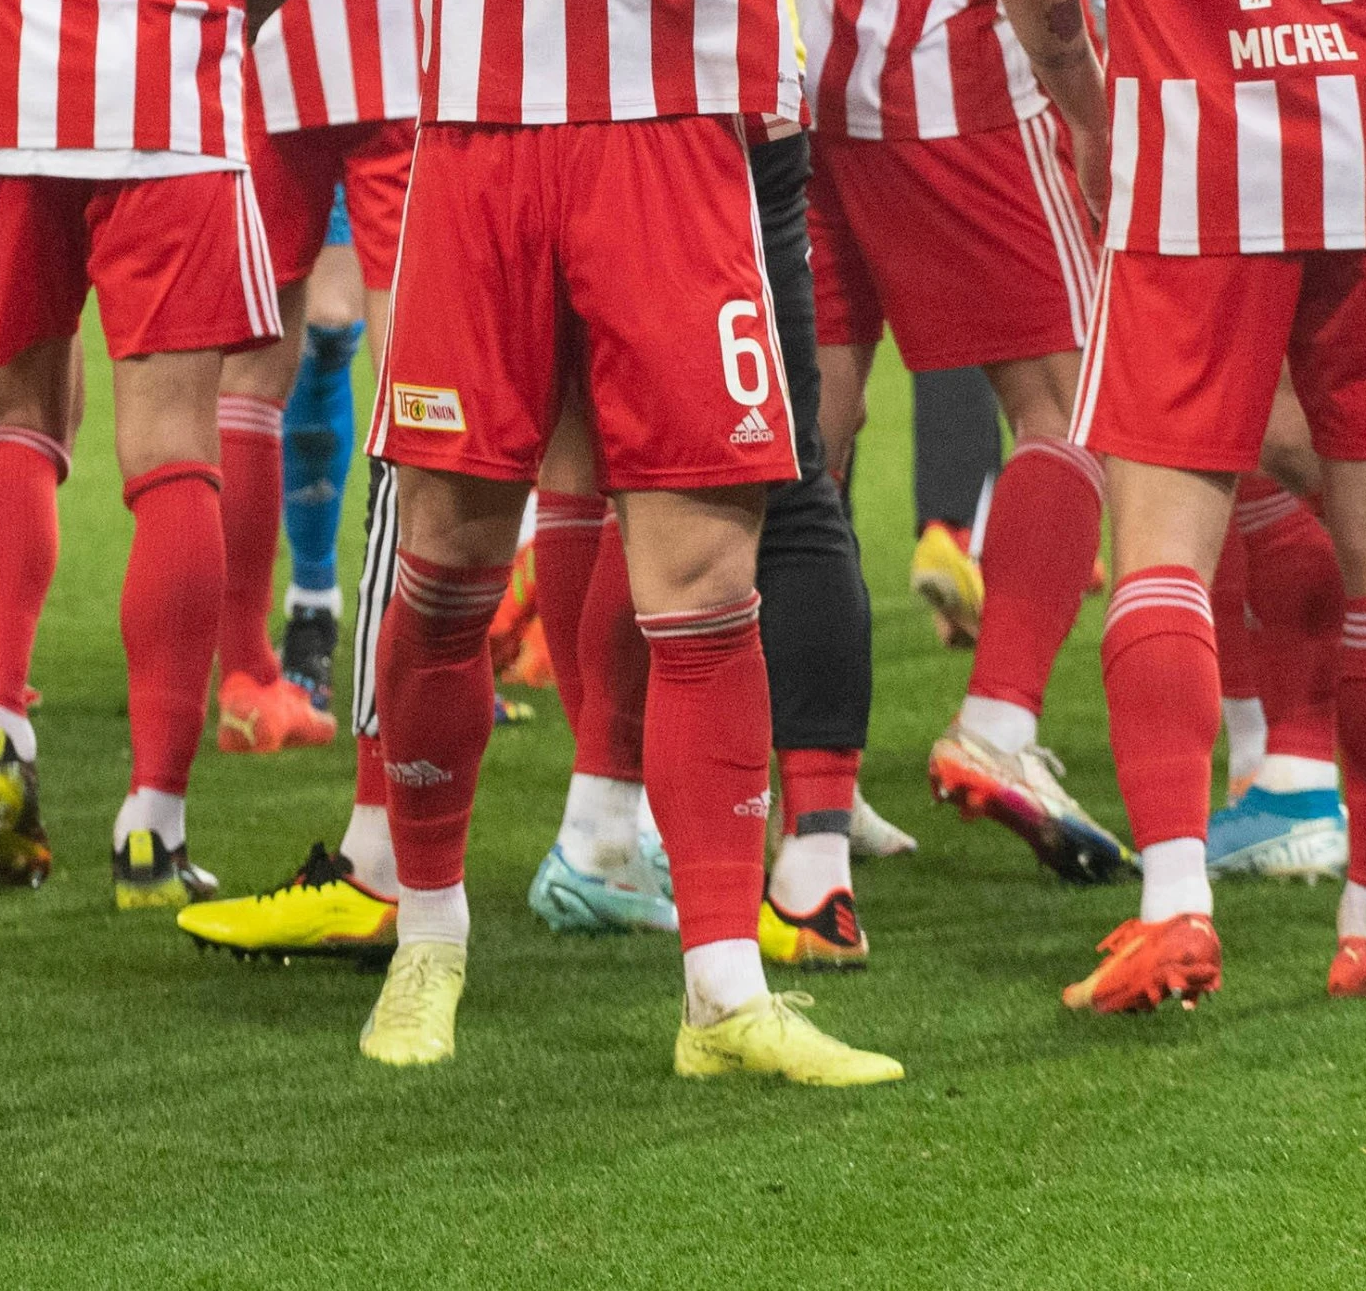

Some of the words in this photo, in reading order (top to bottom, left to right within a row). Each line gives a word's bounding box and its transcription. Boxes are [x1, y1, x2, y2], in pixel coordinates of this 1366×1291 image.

[1228, 23, 1359, 70] MICHEL
[718, 299, 769, 406] 6
[729, 428, 775, 444] adidas
